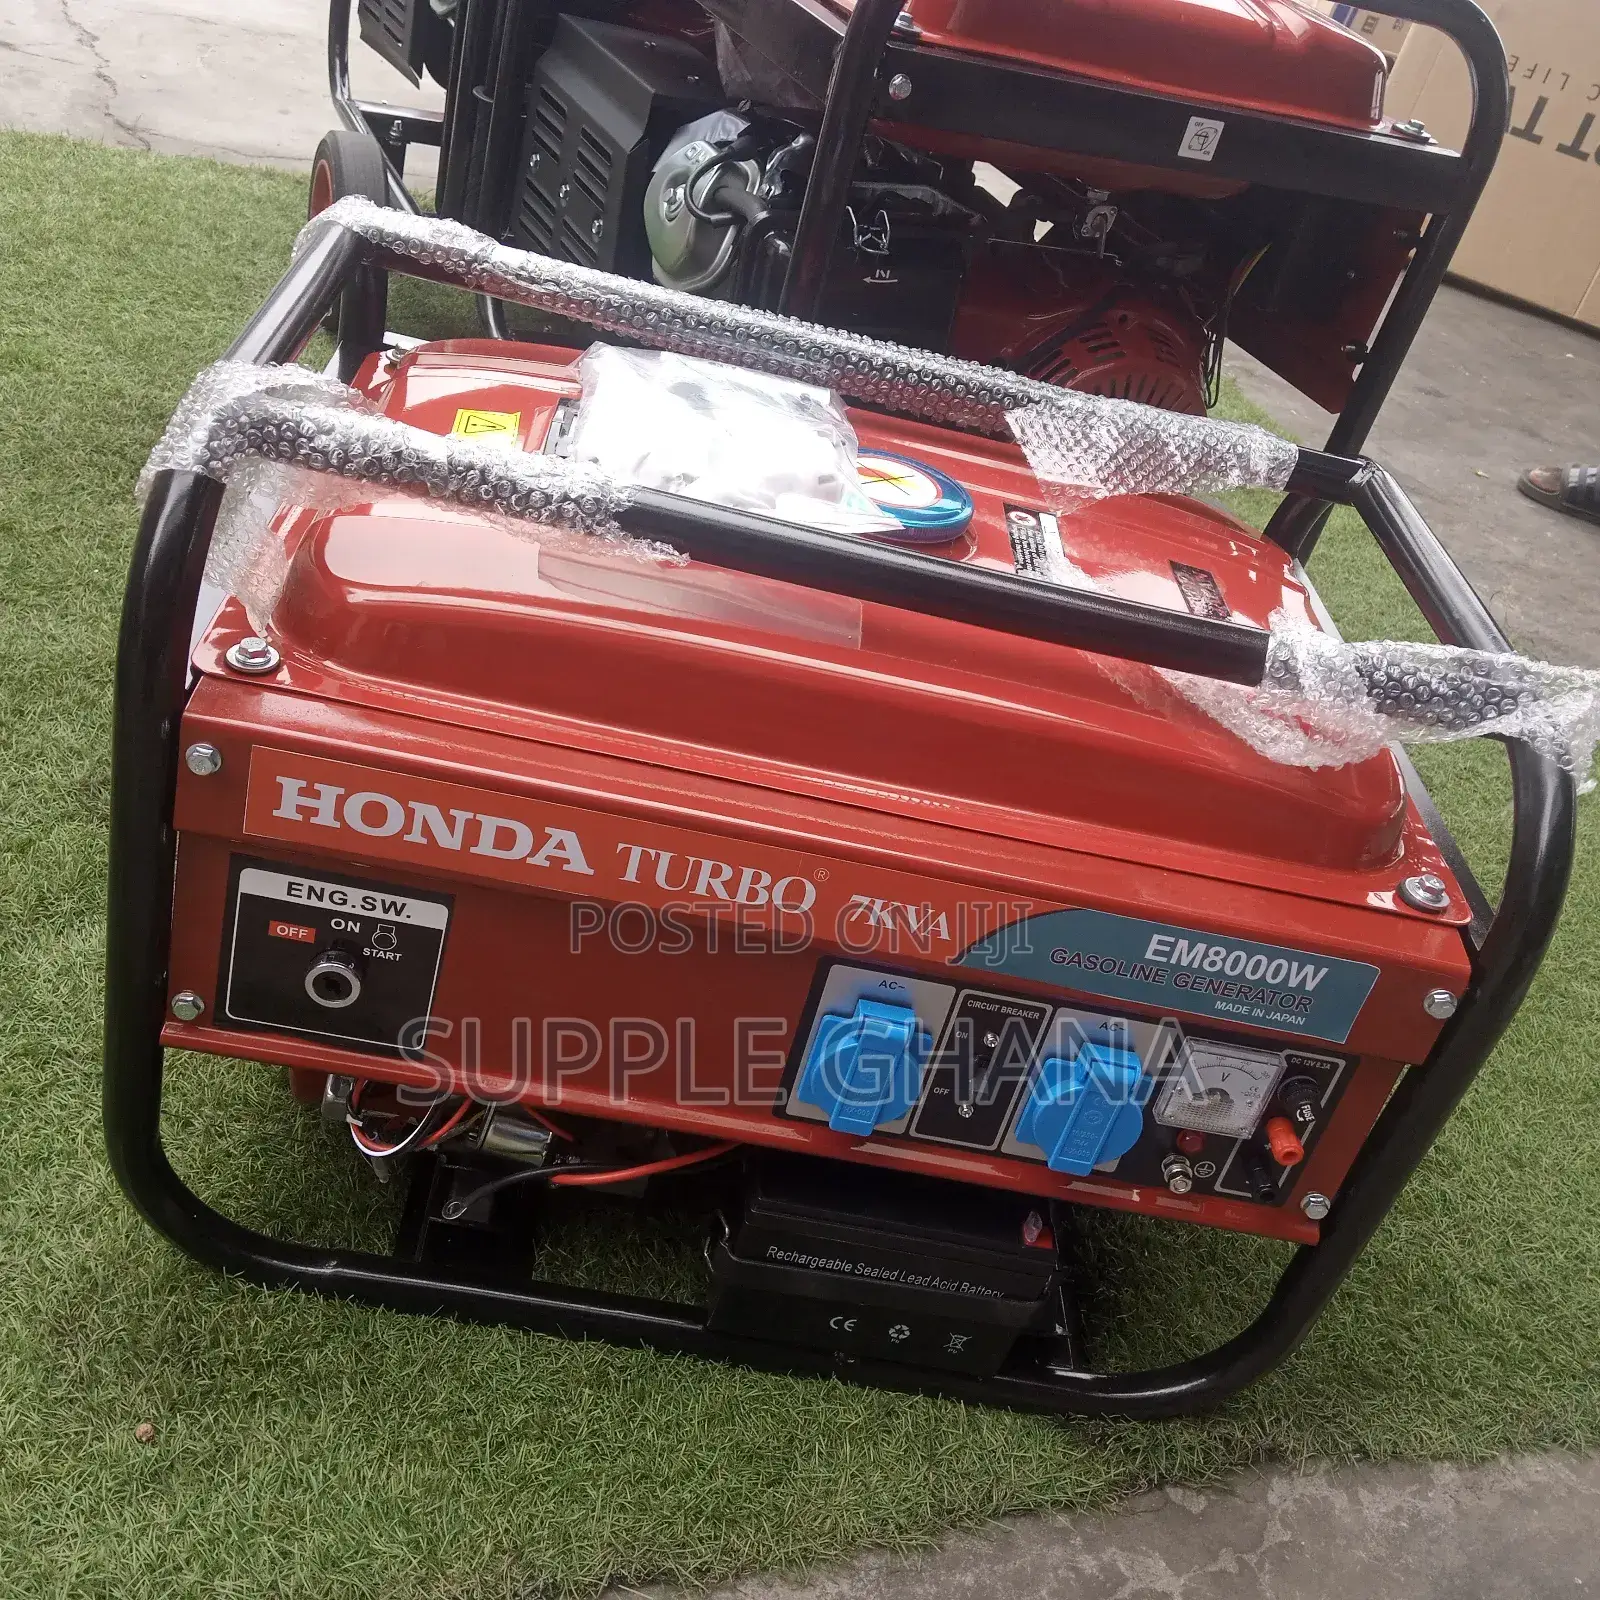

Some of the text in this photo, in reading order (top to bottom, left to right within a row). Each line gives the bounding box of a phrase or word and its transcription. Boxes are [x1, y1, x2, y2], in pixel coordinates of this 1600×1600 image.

[1508, 54, 1571, 92] LIFE
[272, 775, 952, 942] HONDA TURBO 7KVA
[285, 882, 412, 919] ENG.SW.
[276, 924, 309, 940] OFF
[330, 917, 361, 934] ON
[362, 947, 403, 962] START
[1144, 933, 1329, 993] EM8000W
[1049, 947, 1314, 1014] GASOLINE GENERATOR
[967, 999, 1040, 1020] CIRCUIT BREAKER
[1214, 1000, 1306, 1026] MADE IN JAPAN
[956, 1030, 969, 1040] ON
[1290, 1057, 1302, 1065] DC
[1303, 1058, 1316, 1067] 12V
[1221, 1072, 1231, 1083] V
[933, 1086, 951, 1097] OFF
[1301, 1104, 1316, 1122] FUSE
[766, 1245, 1004, 1298] Rechargeable Sealed Lead Acid Battery
[829, 1316, 857, 1334] CE
